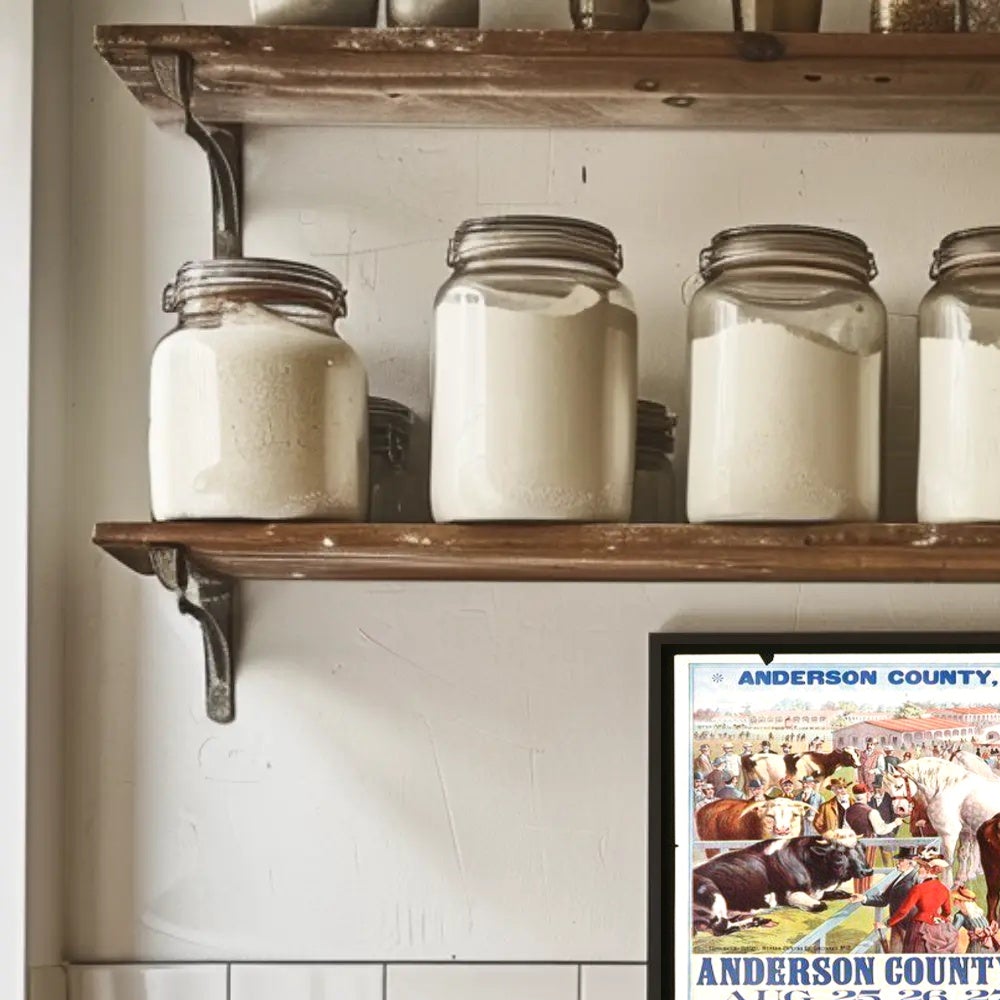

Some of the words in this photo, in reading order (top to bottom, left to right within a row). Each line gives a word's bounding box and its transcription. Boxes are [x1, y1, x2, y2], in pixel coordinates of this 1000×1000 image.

[738, 670, 877, 685] ANDERSON
[888, 670, 998, 686] COUNTY,
[696, 957, 875, 985] ANDERSON
